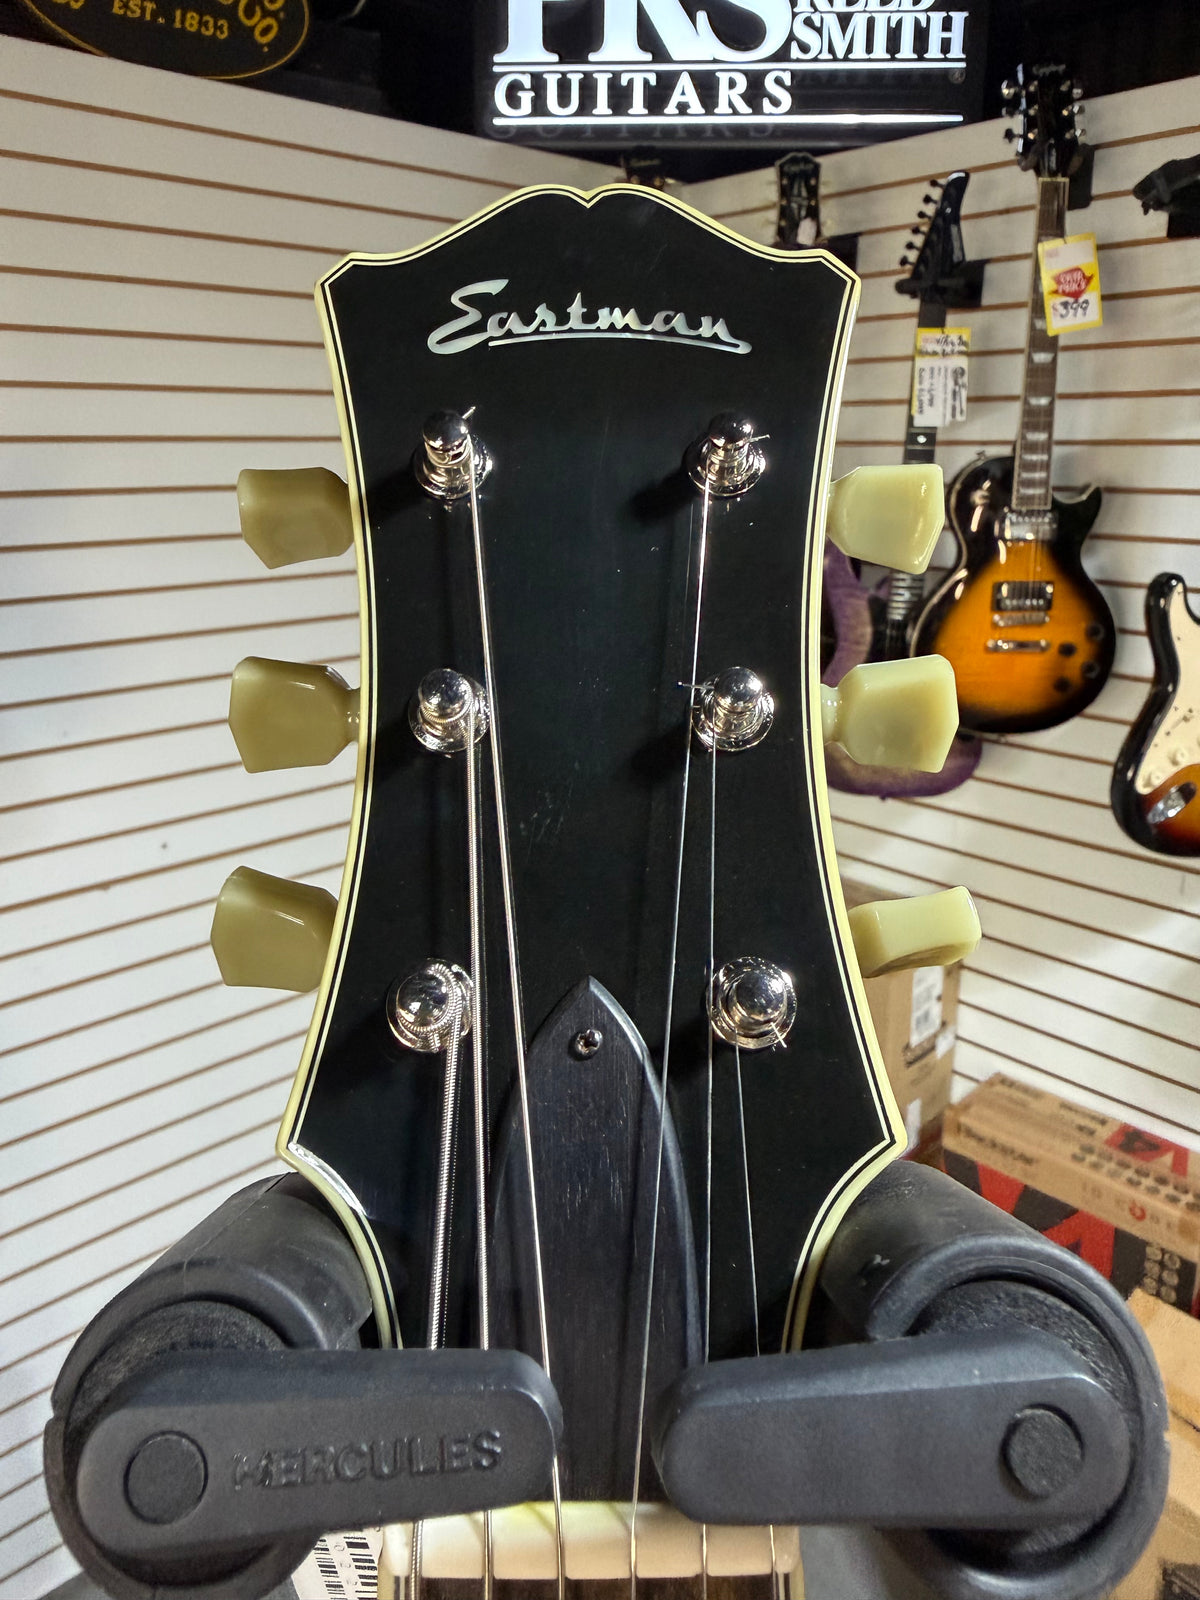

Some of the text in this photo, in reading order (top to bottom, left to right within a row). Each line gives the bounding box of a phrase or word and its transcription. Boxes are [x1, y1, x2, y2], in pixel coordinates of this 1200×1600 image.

[173, 8, 229, 39] 1833
[790, 11, 969, 60] SMITH
[493, 71, 793, 117] GUITARS
[427, 279, 752, 354] Eastman
[233, 1430, 501, 1489] HERCULES
